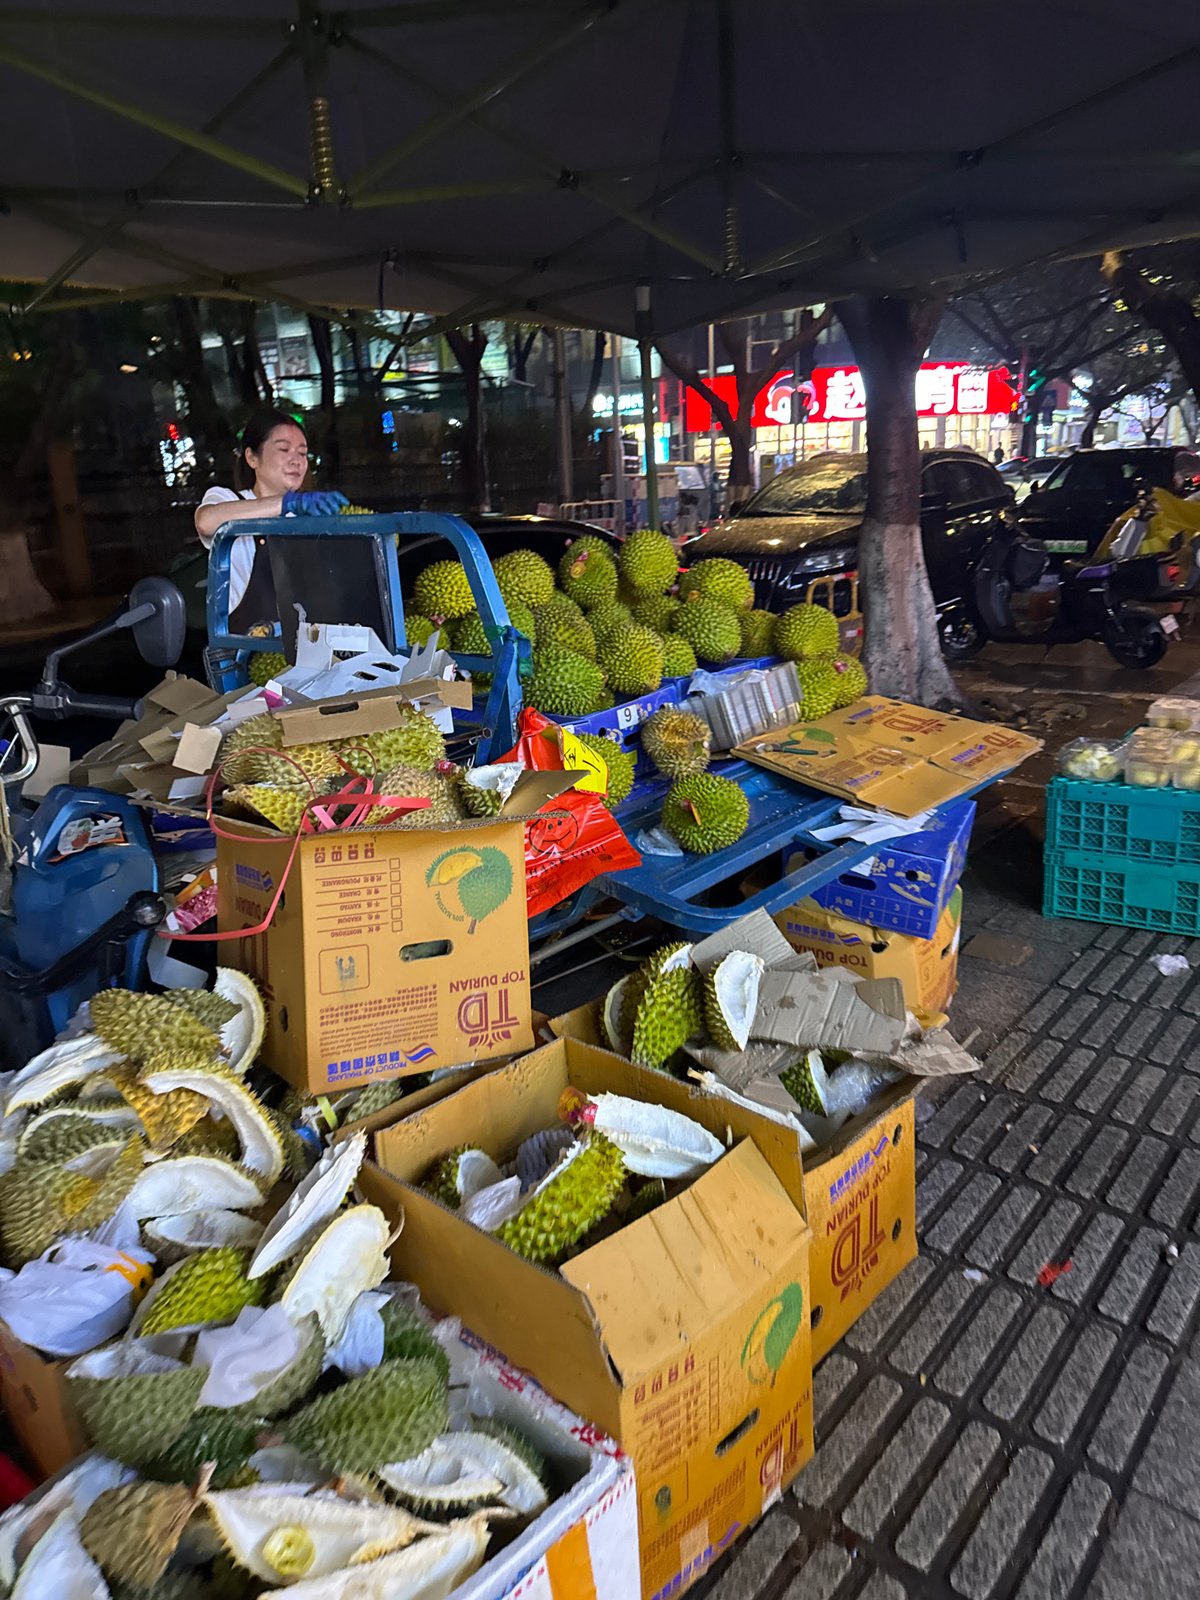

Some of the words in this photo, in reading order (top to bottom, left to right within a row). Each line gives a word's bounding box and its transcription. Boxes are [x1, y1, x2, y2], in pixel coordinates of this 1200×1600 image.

[840, 954, 868, 967] TOP
[502, 969, 525, 983] TOP
[449, 974, 498, 993] DURIAN
[457, 988, 520, 1036] TD
[364, 1068, 374, 1076] OF
[376, 1061, 407, 1074] PRODUCT
[327, 1071, 363, 1083] THAILAND
[826, 1181, 869, 1236] DURIAN
